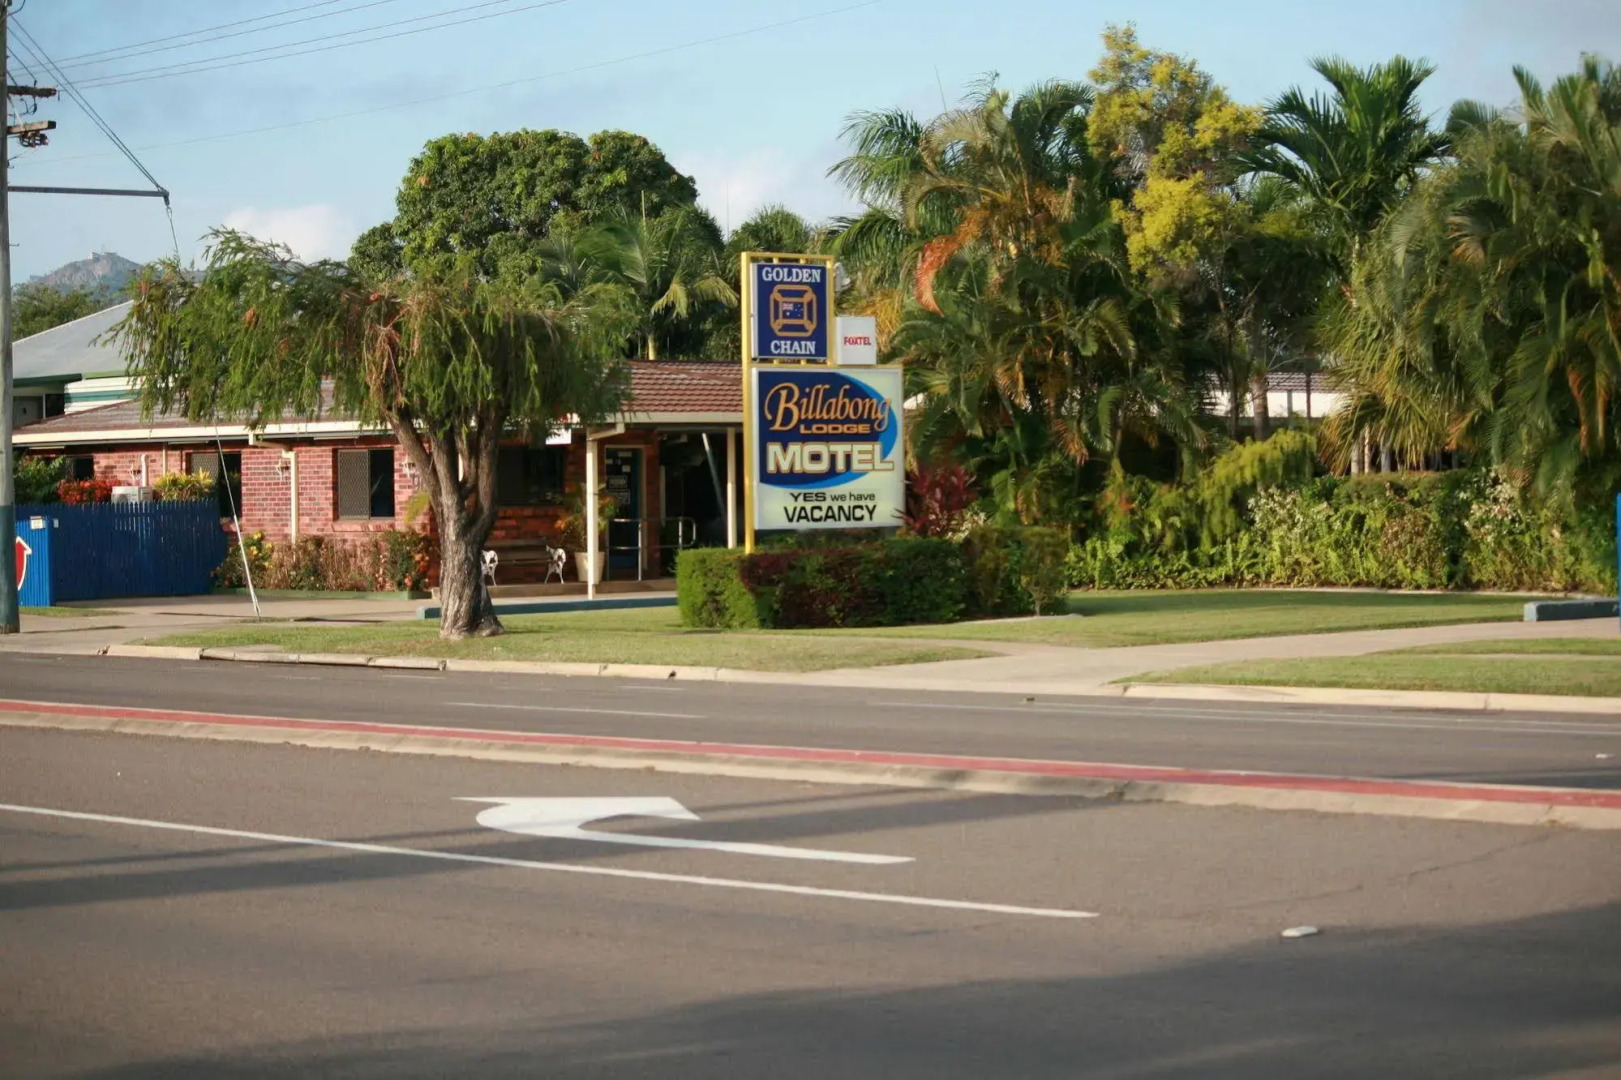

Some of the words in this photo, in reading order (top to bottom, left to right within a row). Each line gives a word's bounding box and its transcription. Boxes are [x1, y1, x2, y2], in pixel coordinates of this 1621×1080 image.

[762, 267, 821, 283] GOLDEN
[770, 341, 816, 355] CHAIN
[843, 336, 872, 346] FOXTEL
[764, 382, 892, 431] Billabong
[800, 423, 870, 434] LODGE
[766, 441, 894, 474] MOTEL
[790, 492, 827, 502] YES
[830, 494, 847, 502] we
[849, 491, 876, 501] have
[784, 505, 877, 524] VACANCY
